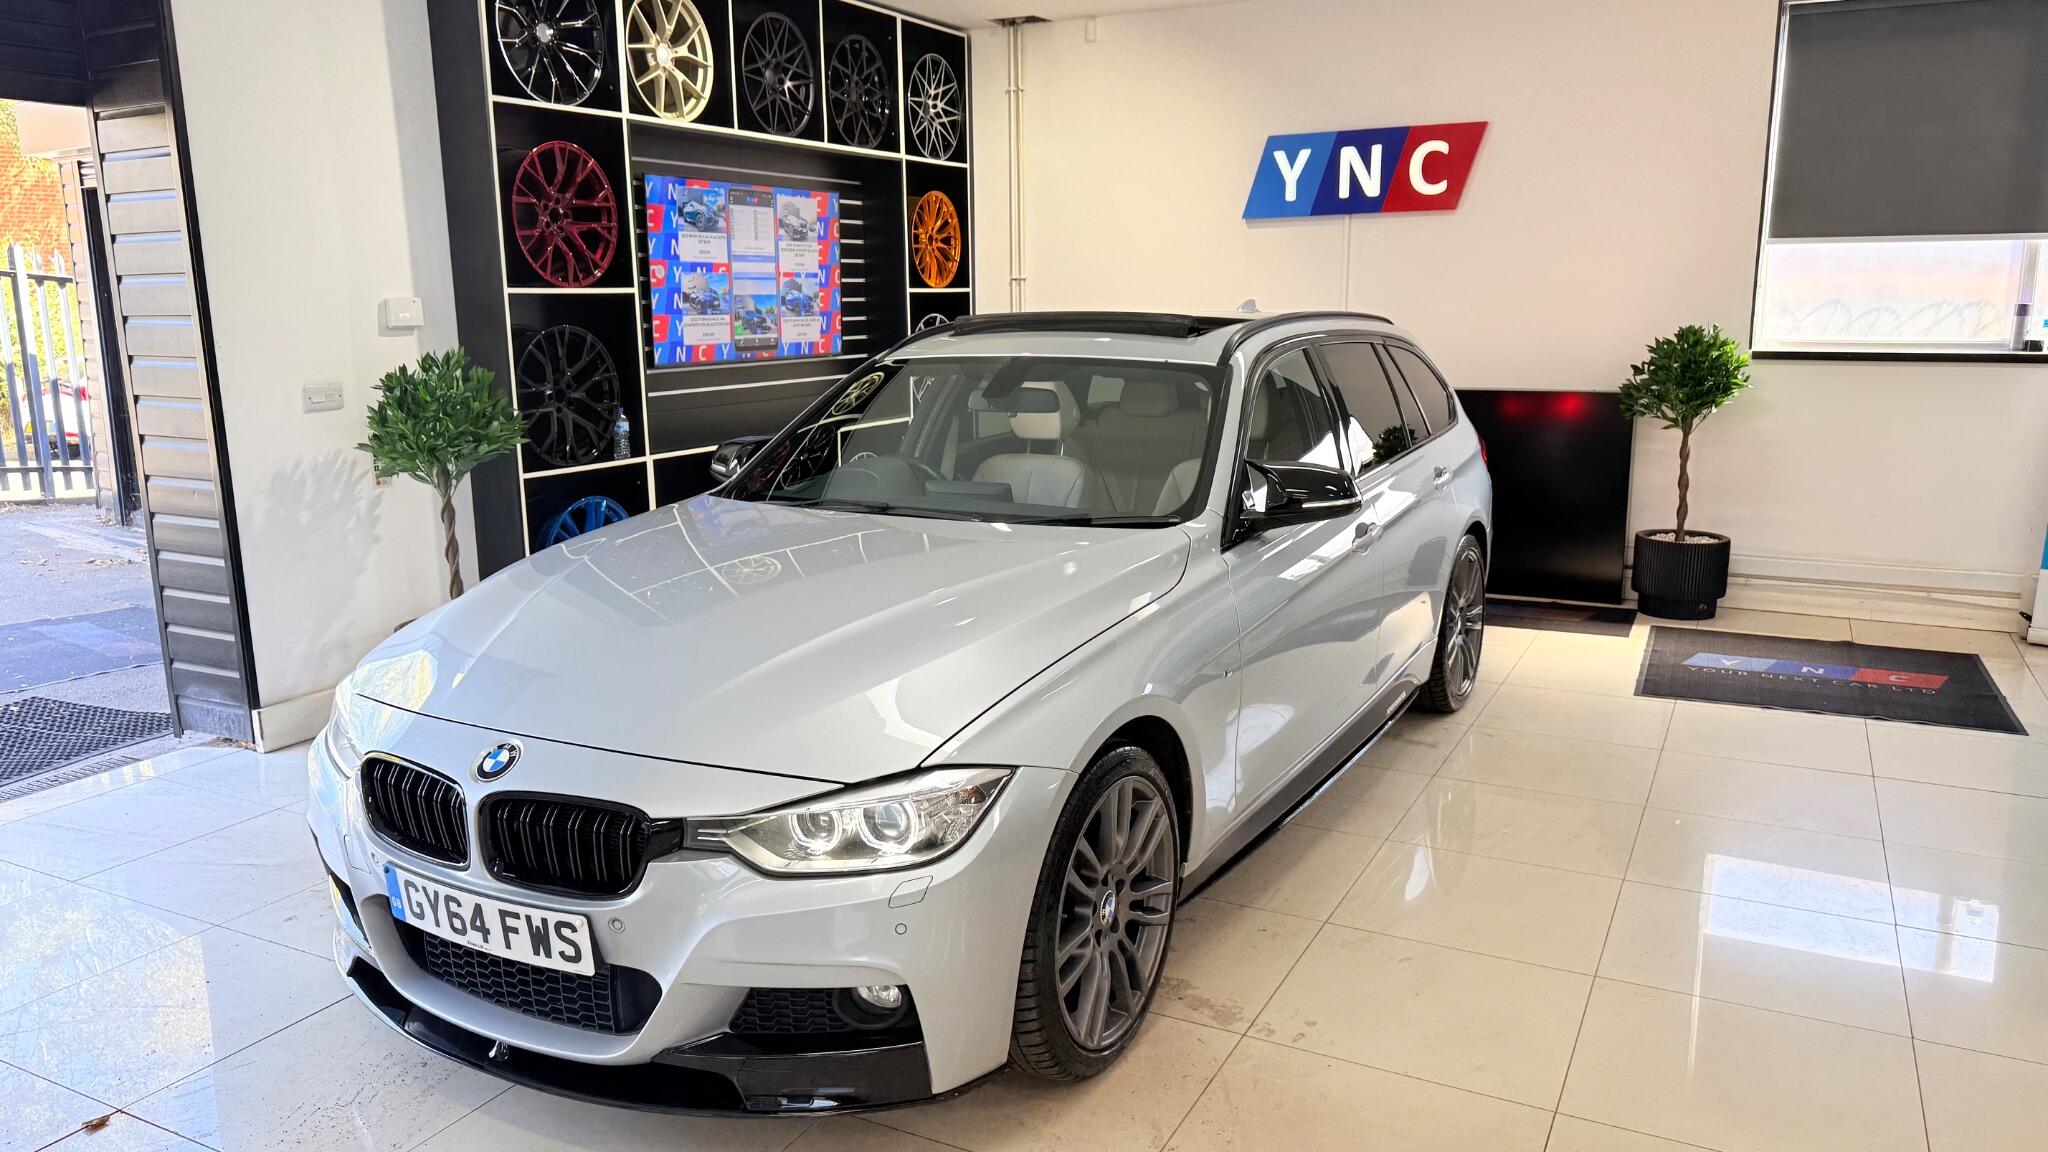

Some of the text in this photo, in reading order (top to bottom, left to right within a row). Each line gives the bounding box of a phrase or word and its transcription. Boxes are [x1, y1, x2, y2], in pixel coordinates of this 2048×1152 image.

[1688, 666, 1937, 694] YOUR NEXT CAR LTD
[403, 879, 582, 964] GY64 FWS
